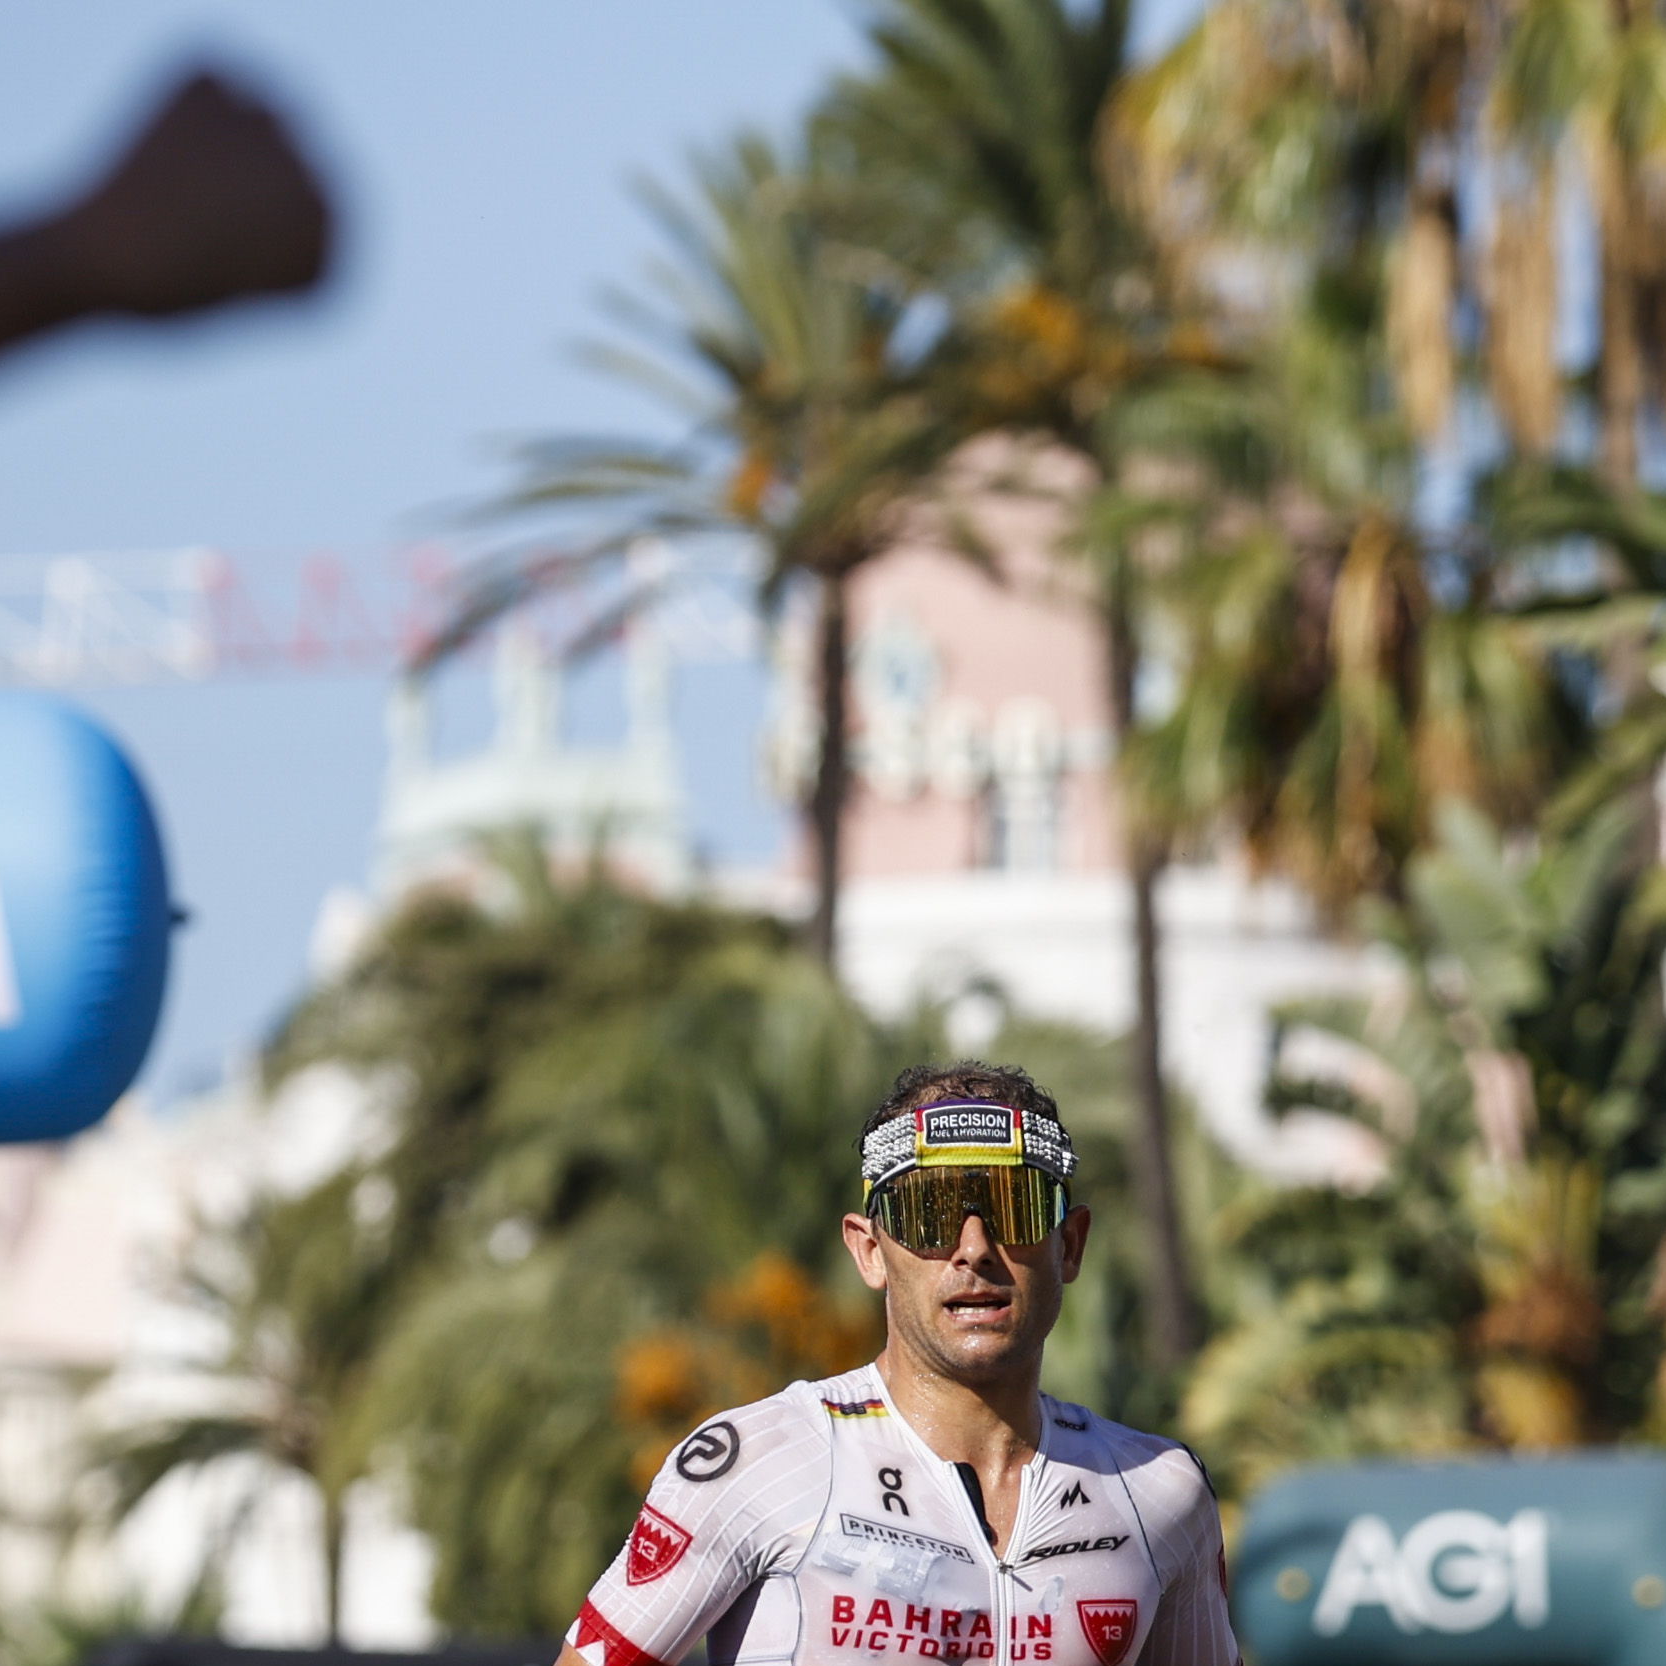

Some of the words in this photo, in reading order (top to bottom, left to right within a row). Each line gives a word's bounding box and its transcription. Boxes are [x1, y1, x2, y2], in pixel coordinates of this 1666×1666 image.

[930, 1112, 1007, 1130] PRECISION
[930, 1128, 951, 1138] FUEL
[959, 1127, 1007, 1138] HYDRATION
[636, 1536, 659, 1562] 13
[848, 1519, 966, 1559] PRINCETON
[1021, 1534, 1131, 1562] RIDLEY
[1312, 1507, 1553, 1637] AG1
[831, 1594, 1054, 1639] BAHRAIN
[830, 1626, 1053, 1661] VICTORIOUS
[1101, 1625, 1123, 1641] 13
